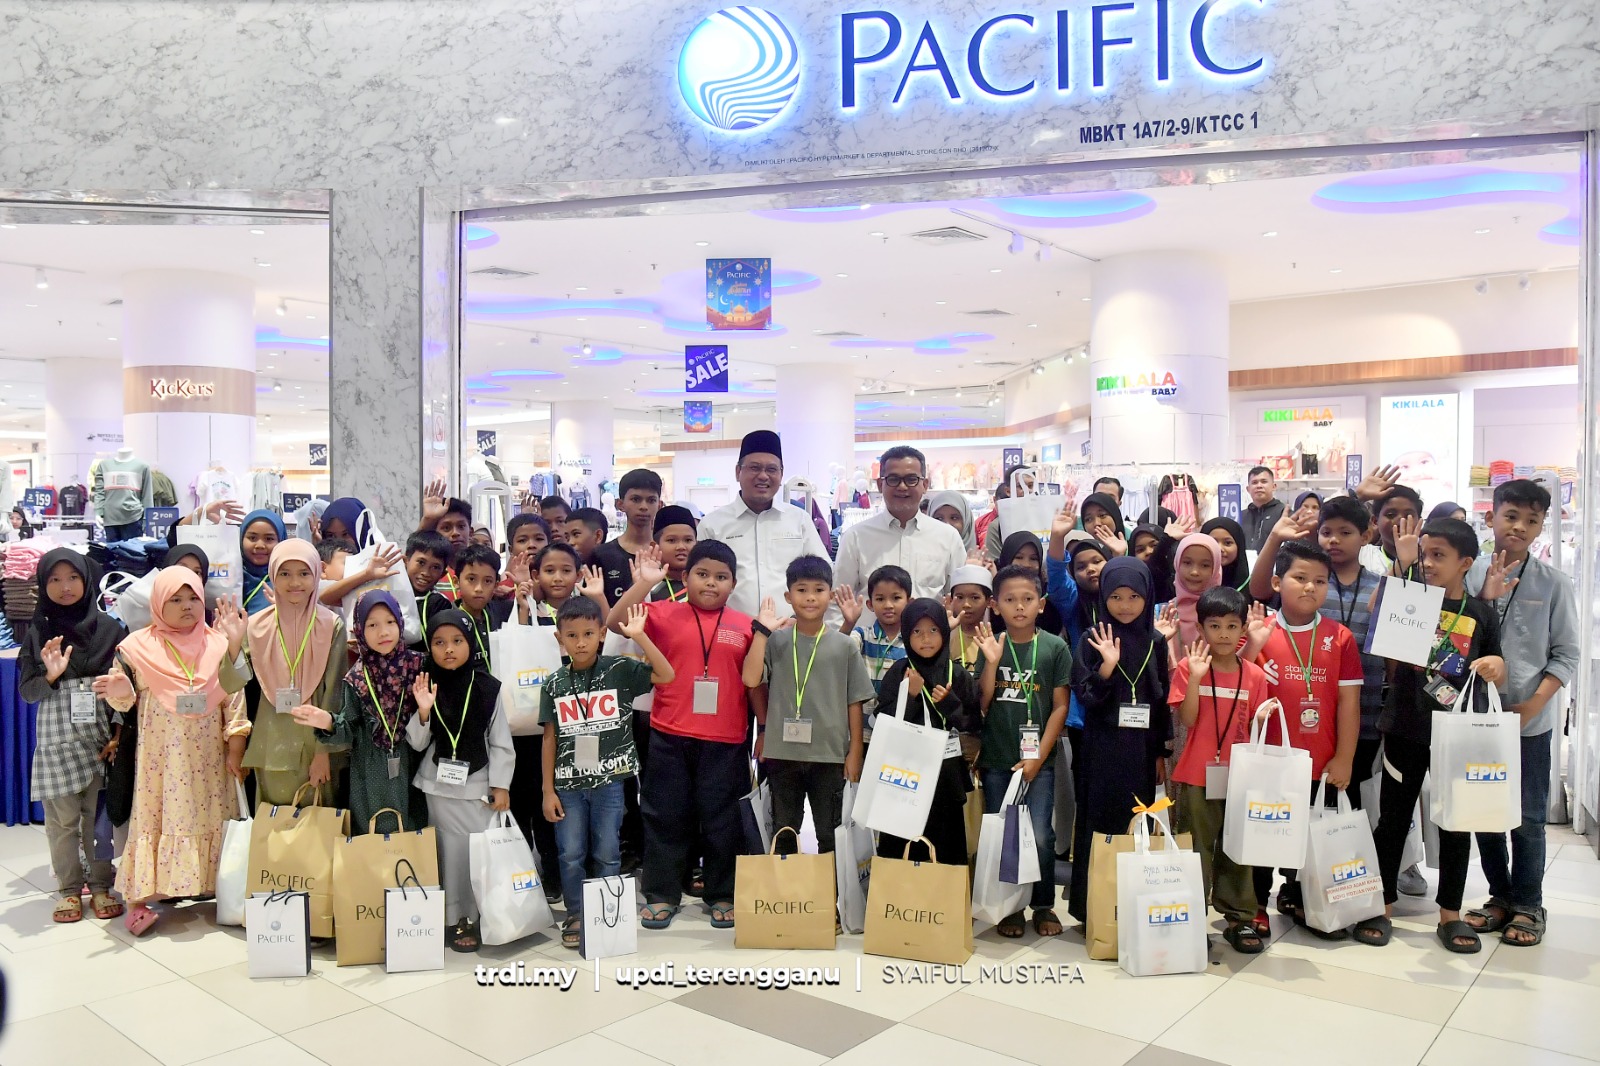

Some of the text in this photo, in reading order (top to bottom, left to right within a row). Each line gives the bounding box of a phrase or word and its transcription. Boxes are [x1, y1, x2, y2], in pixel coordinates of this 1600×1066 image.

[841, 0, 1264, 108] PACIFIC
[1080, 112, 1258, 144] MBKT 1A7/2-9/KTCC 1
[814, 154, 859, 162] HYPERMARKET
[866, 150, 915, 158] DEPARTMENTAL
[695, 349, 715, 362] PACIFIC
[686, 352, 728, 388] SALE
[1152, 388, 1177, 396] BABY
[1392, 399, 1445, 409] KIKILALA
[1264, 408, 1334, 422] KIKILALA
[477, 435, 496, 453] SALE
[310, 448, 327, 464] SALE
[1005, 454, 1020, 466] 49
[1348, 460, 1359, 471] 39
[1347, 475, 1359, 487] 49
[35, 493, 51, 506] 159
[152, 512, 159, 520] 2
[1221, 502, 1239, 520] 79
[208, 563, 228, 578] PIC
[1389, 613, 1428, 630] PACIFIC
[559, 694, 616, 723] NYC
[555, 766, 573, 780] NEW
[607, 754, 629, 770] CITY
[1468, 766, 1505, 780] EPIC
[881, 767, 919, 789] EPIC
[1250, 804, 1290, 819] EPIC
[1334, 860, 1365, 881] EPIC
[260, 870, 315, 890] PACIFIC
[514, 872, 540, 890] EPI
[754, 899, 814, 915] PACIFIC
[884, 904, 944, 925] PACIFIC
[1151, 906, 1186, 922] EPIC
[594, 914, 628, 926] PACIIC
[258, 934, 295, 944] PACIFIC
[397, 928, 435, 937] PACIFIC
